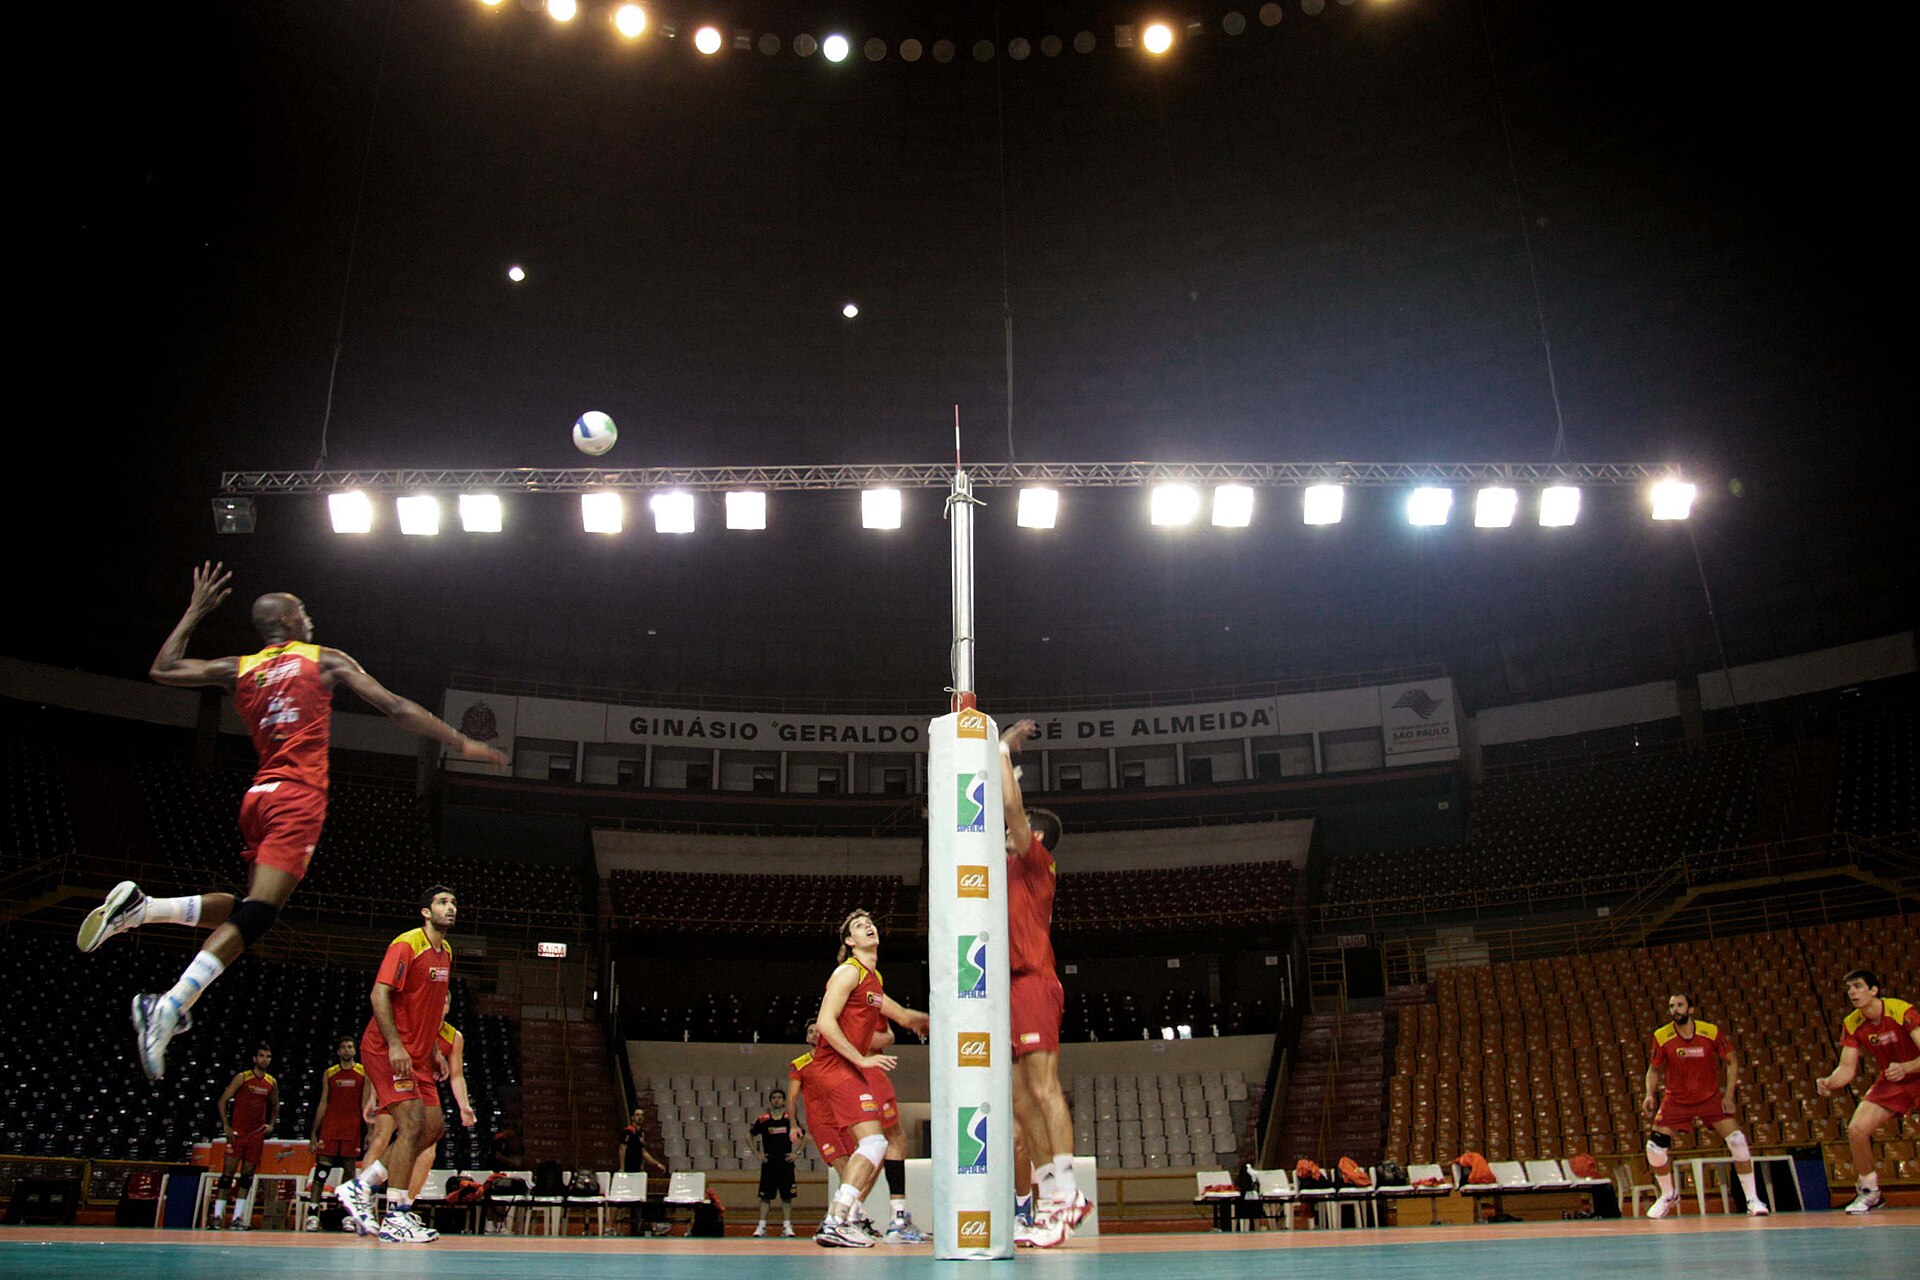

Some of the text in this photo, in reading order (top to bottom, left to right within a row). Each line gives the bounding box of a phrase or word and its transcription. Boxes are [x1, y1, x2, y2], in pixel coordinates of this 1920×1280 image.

[630, 716, 758, 740] GINÁSIO
[1077, 721, 1115, 739] DE
[960, 716, 985, 729] GOL
[1392, 727, 1450, 740] SÃO PAULO
[960, 874, 986, 887] GOL
[957, 990, 987, 999] SUPERLIGA
[960, 1041, 987, 1055] GOL
[957, 1164, 988, 1174] SUPERLIGA
[961, 1221, 988, 1236] GOL
